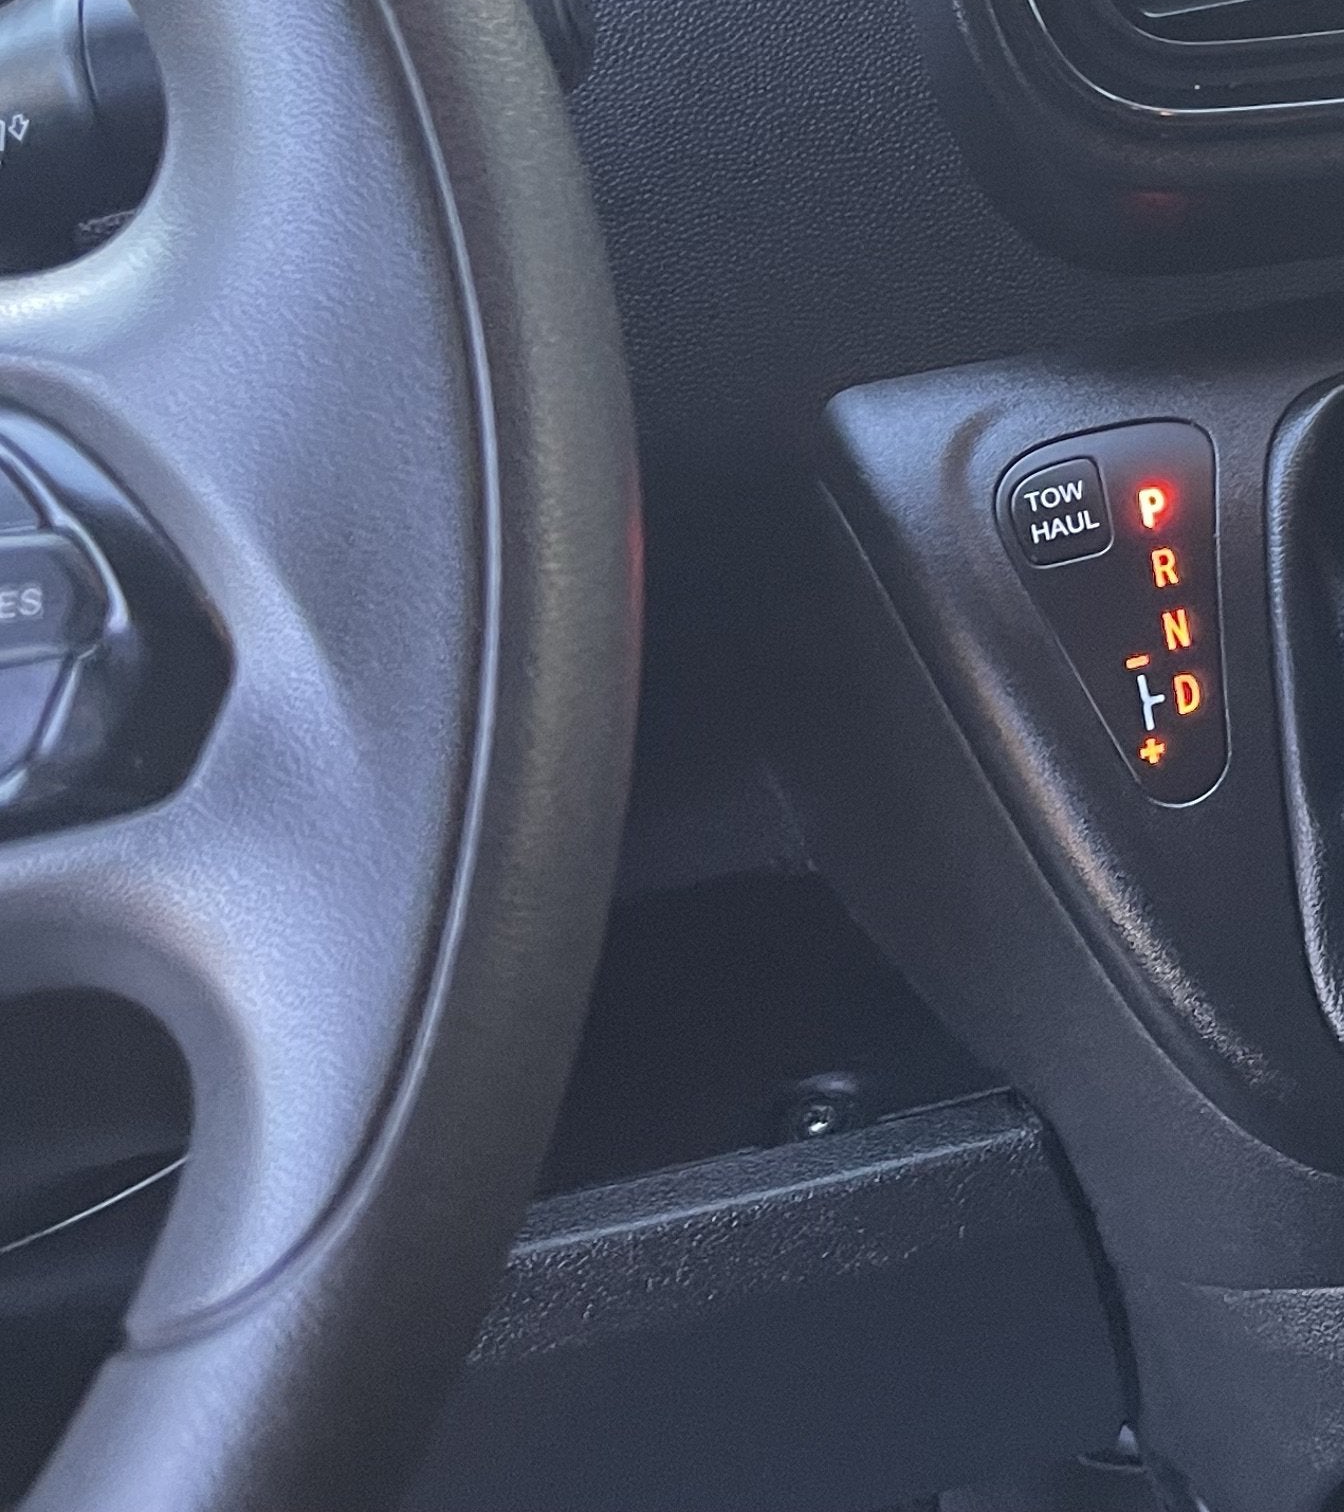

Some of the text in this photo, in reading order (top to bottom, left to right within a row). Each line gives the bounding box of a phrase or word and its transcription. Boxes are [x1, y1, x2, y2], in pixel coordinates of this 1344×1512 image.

[1024, 479, 1084, 512] TOW
[1138, 487, 1166, 529] P
[1031, 510, 1100, 544] HAUL
[1151, 547, 1179, 588] R
[1162, 608, 1192, 651] N
[1174, 673, 1201, 715] D
